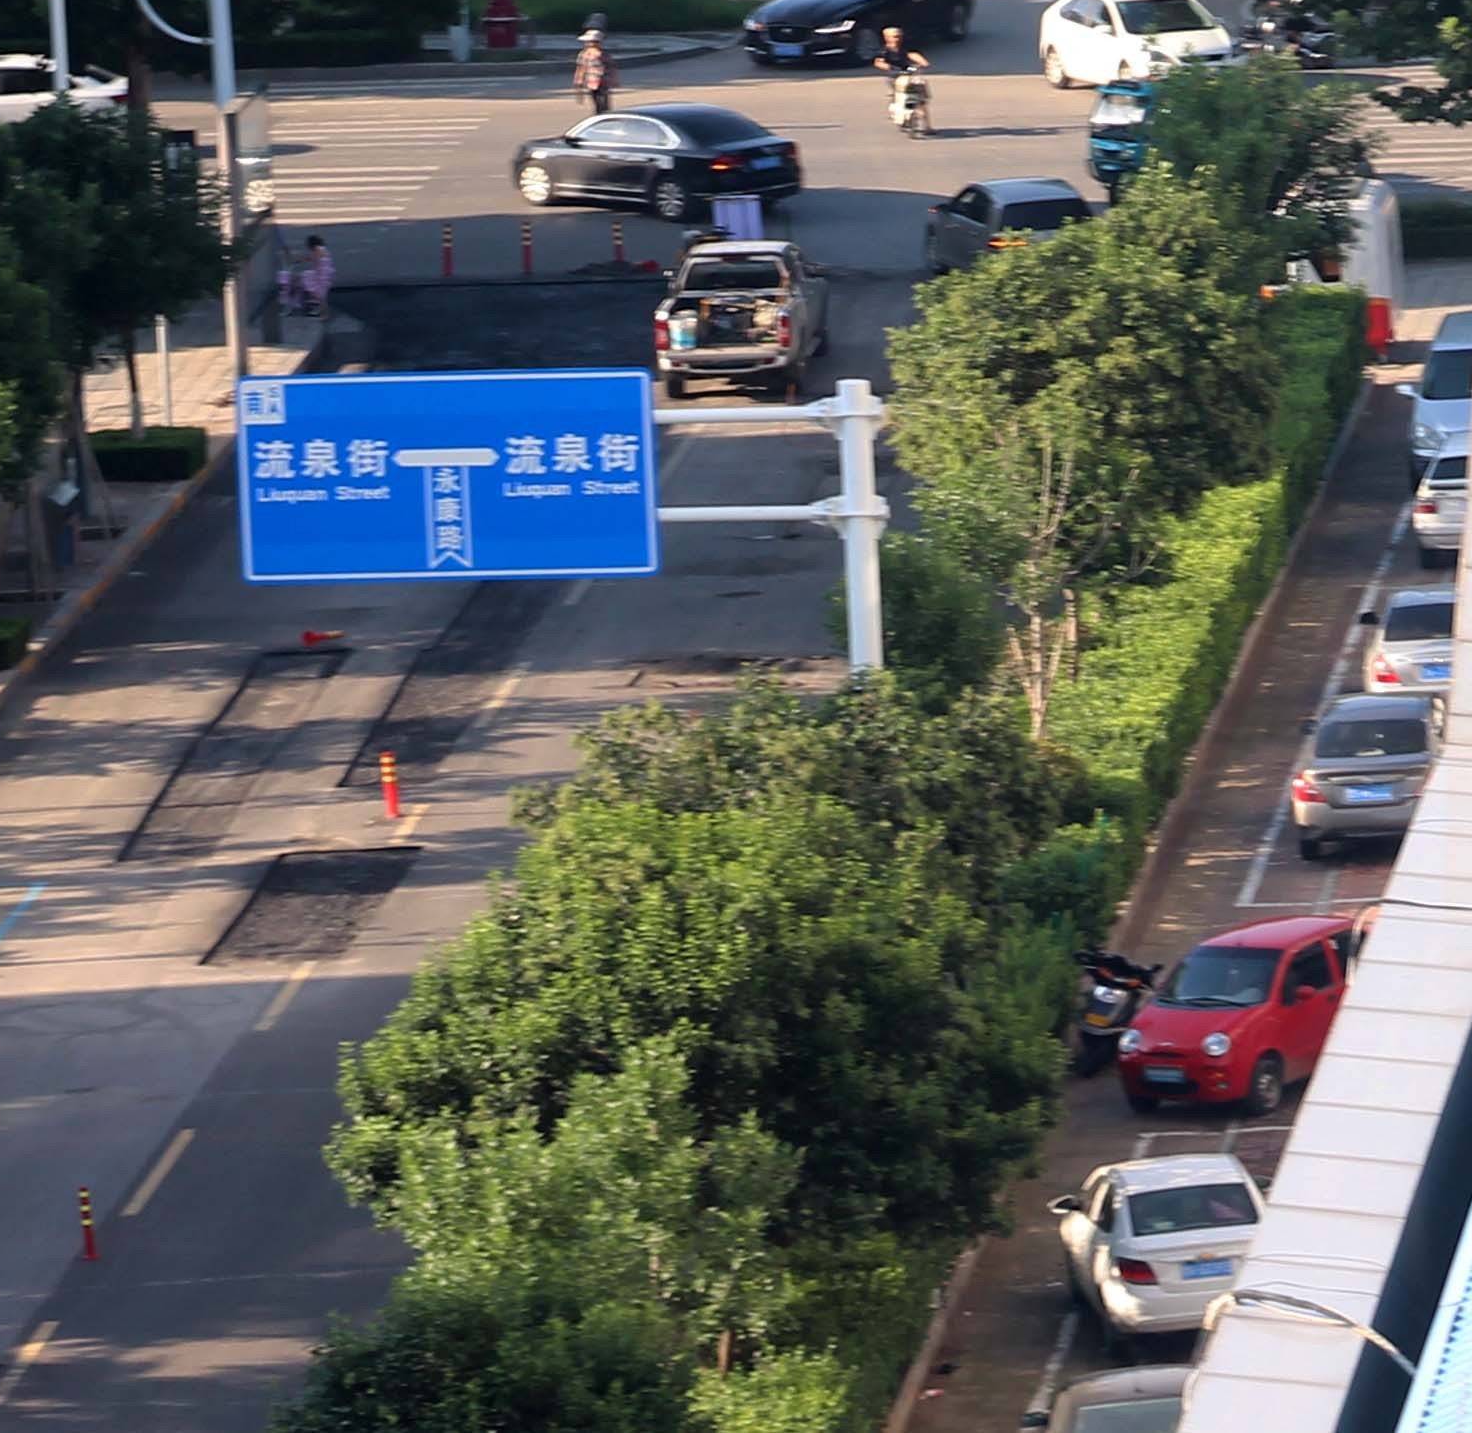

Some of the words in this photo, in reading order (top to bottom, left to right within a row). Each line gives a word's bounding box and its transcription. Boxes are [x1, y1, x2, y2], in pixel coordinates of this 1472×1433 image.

[253, 437, 390, 480] 流泉街
[504, 433, 641, 475] 流泉街
[256, 487, 328, 504] Liuquan
[334, 485, 391, 501] Street
[433, 467, 464, 550] 永康路
[502, 482, 573, 499] Liuquan
[581, 480, 641, 496] Street
